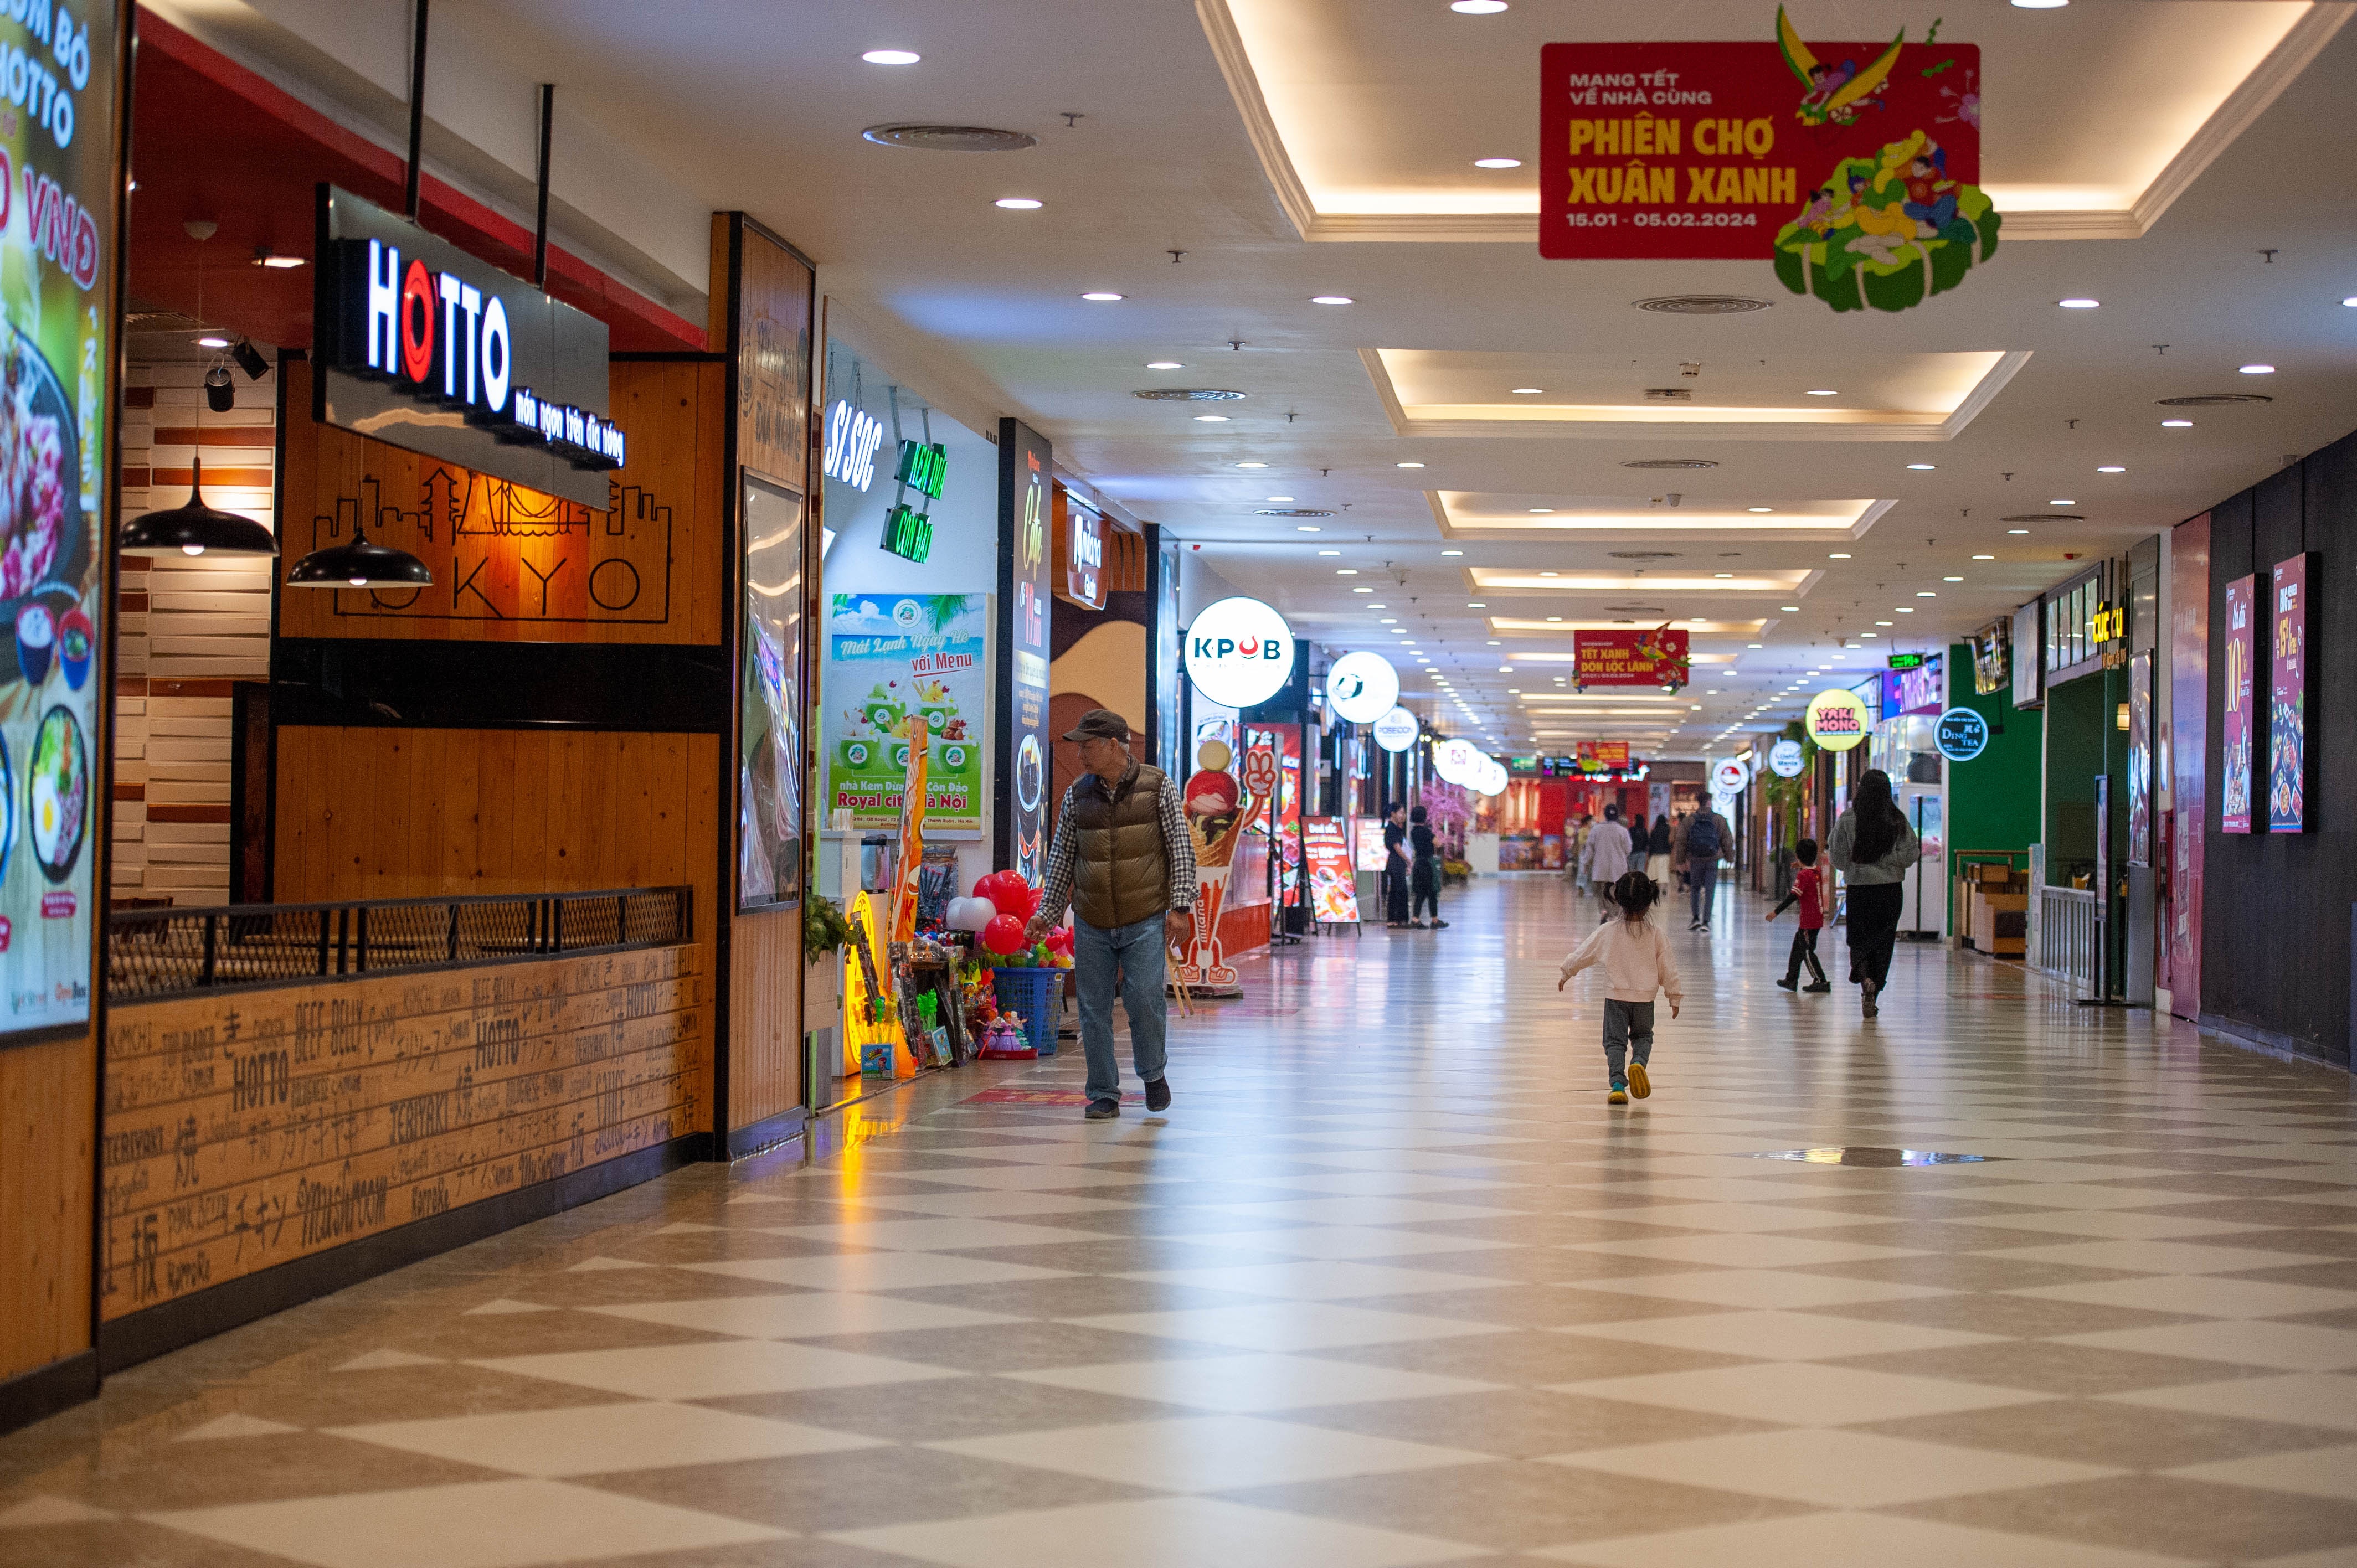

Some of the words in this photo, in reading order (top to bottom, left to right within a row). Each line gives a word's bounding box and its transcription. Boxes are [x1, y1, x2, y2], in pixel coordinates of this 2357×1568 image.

[1569, 74, 1635, 87] MANG
[1640, 69, 1679, 87] TẾT
[1602, 88, 1648, 105] NHÀ
[1652, 89, 1712, 105] CÙNG
[1569, 111, 1680, 155] PHIÊN
[1693, 115, 1774, 159] CHỢ
[1567, 159, 1675, 204] XUÂN
[1686, 167, 1797, 204] XANH
[1566, 213, 1618, 227] 15.01
[1633, 213, 1757, 227] 05.02.2024
[367, 238, 511, 412] HOTTO
[515, 389, 537, 428] món
[540, 401, 564, 443] ngon
[565, 406, 585, 447] trên
[602, 421, 625, 468] nóng
[2093, 600, 2110, 643] cúc
[841, 638, 871, 656] Mát
[873, 636, 907, 654] Lạnh
[910, 634, 948, 652] Ngày
[950, 628, 970, 644] Hè
[1581, 646, 1598, 659] TẾT
[1600, 648, 1629, 659] XANH
[912, 653, 930, 672] với
[935, 652, 972, 669] Menu
[1815, 719, 1860, 731] MONO
[1817, 707, 1855, 720] YAKI
[840, 780, 858, 791] nhà
[860, 781, 883, 791] Kem
[926, 782, 946, 792] Côn
[948, 782, 969, 792] Đảo
[838, 792, 882, 810] Royal
[885, 794, 903, 807] cit
[940, 793, 967, 812] Nội
[1197, 899, 1208, 943] milana
[475, 1017, 519, 1072] HOTTO
[233, 1049, 289, 1112] HOTTO
[389, 1090, 449, 1147] TERIYAKI
